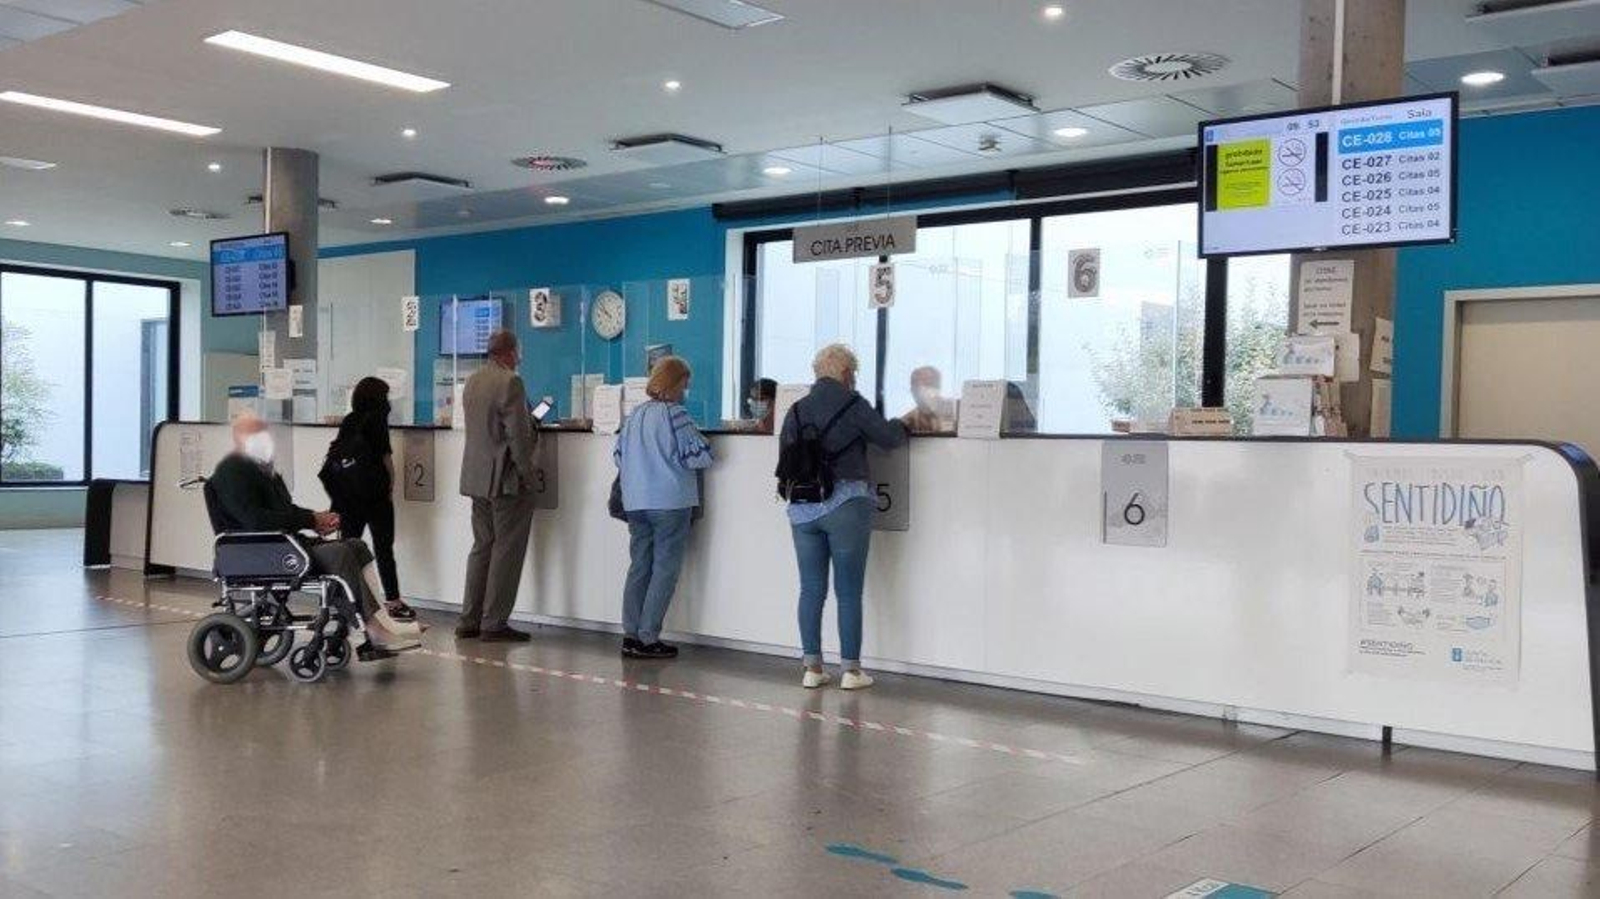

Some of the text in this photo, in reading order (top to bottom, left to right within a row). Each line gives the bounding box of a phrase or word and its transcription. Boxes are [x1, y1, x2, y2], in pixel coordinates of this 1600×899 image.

[1342, 131, 1393, 147] CE-028
[1398, 129, 1425, 140] Citas
[1342, 155, 1392, 170] CE-027
[1399, 154, 1425, 164] Citas
[1342, 172, 1392, 186] CE-026
[1399, 171, 1425, 180] Citas
[1342, 188, 1392, 202] CE-025
[1399, 187, 1425, 196] Citas
[1342, 205, 1392, 219] CE-024
[1399, 204, 1425, 213] Citas
[1342, 221, 1391, 235] CE-023
[1399, 220, 1425, 230] Citas
[810, 233, 896, 256] CITA PREVIA
[874, 266, 893, 304] 5
[1073, 253, 1098, 293] 6
[534, 291, 548, 323] 3
[413, 463, 429, 488] 2
[876, 483, 892, 512] 5
[1123, 492, 1146, 526] 6
[1363, 481, 1508, 526] SENTIDIÑO
